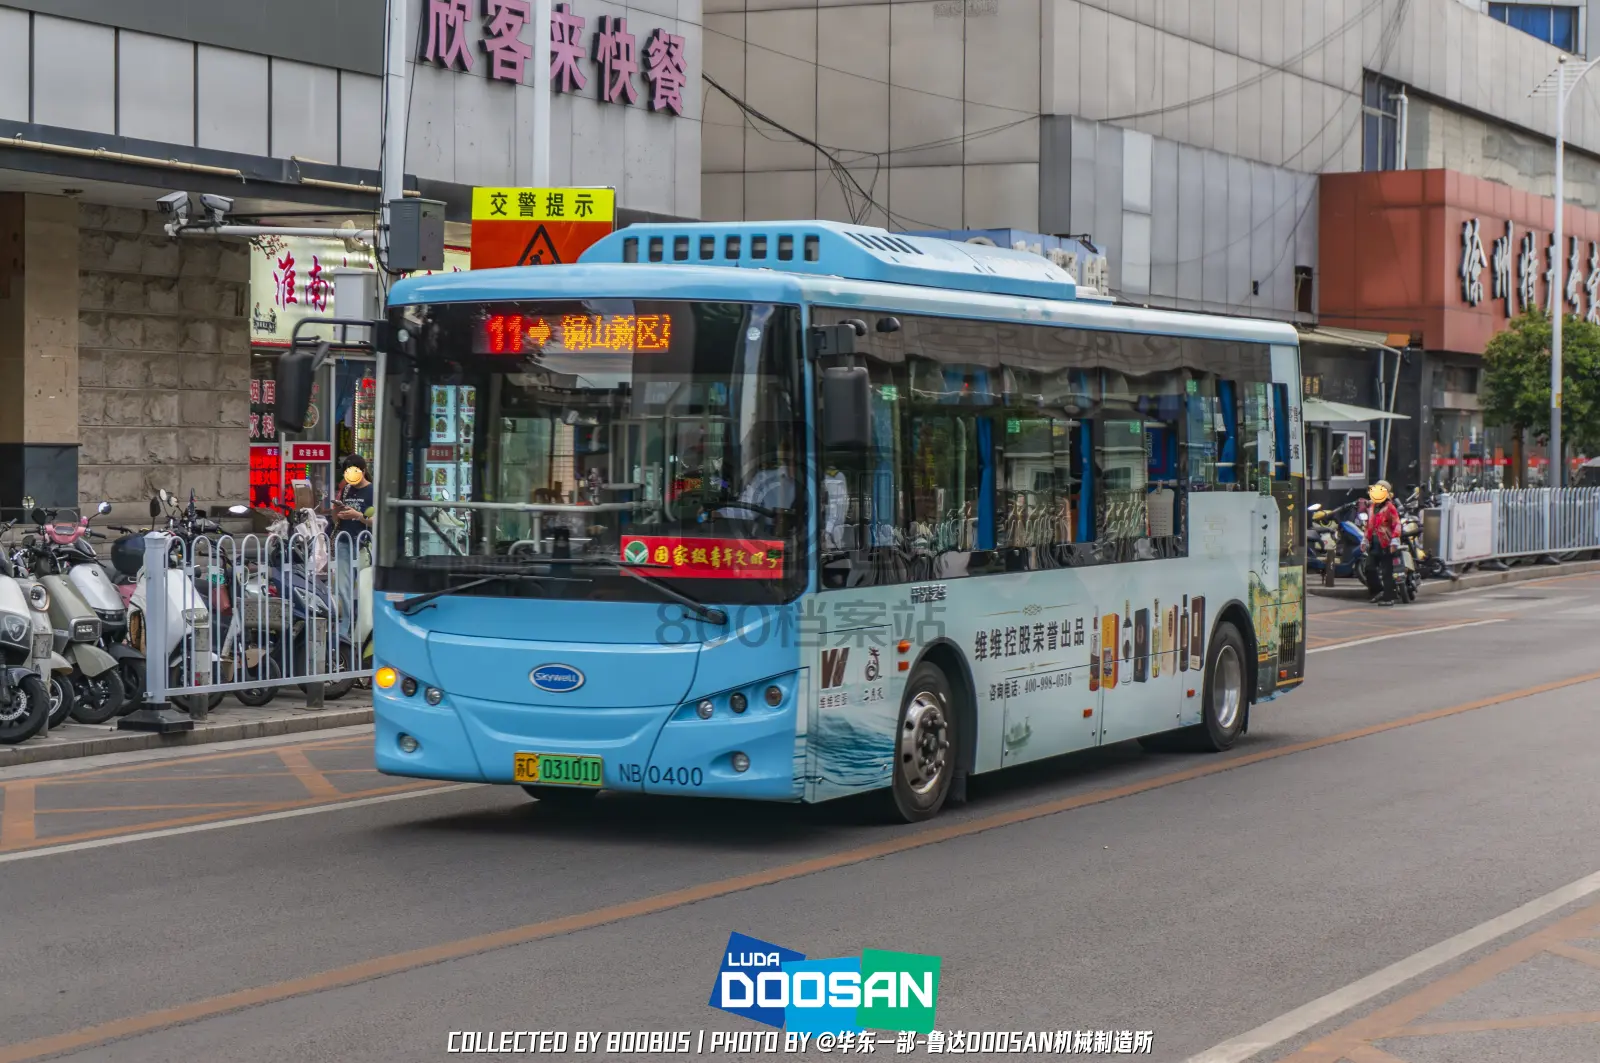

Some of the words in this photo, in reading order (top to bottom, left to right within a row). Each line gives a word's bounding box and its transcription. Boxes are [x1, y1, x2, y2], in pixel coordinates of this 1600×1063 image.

[421, 0, 687, 116] 欣客来快餐
[490, 192, 594, 217] 交警提示
[490, 315, 523, 353] 11
[299, 449, 325, 457] 欢迎光临
[975, 617, 1084, 662] 维维控股荣誉出品
